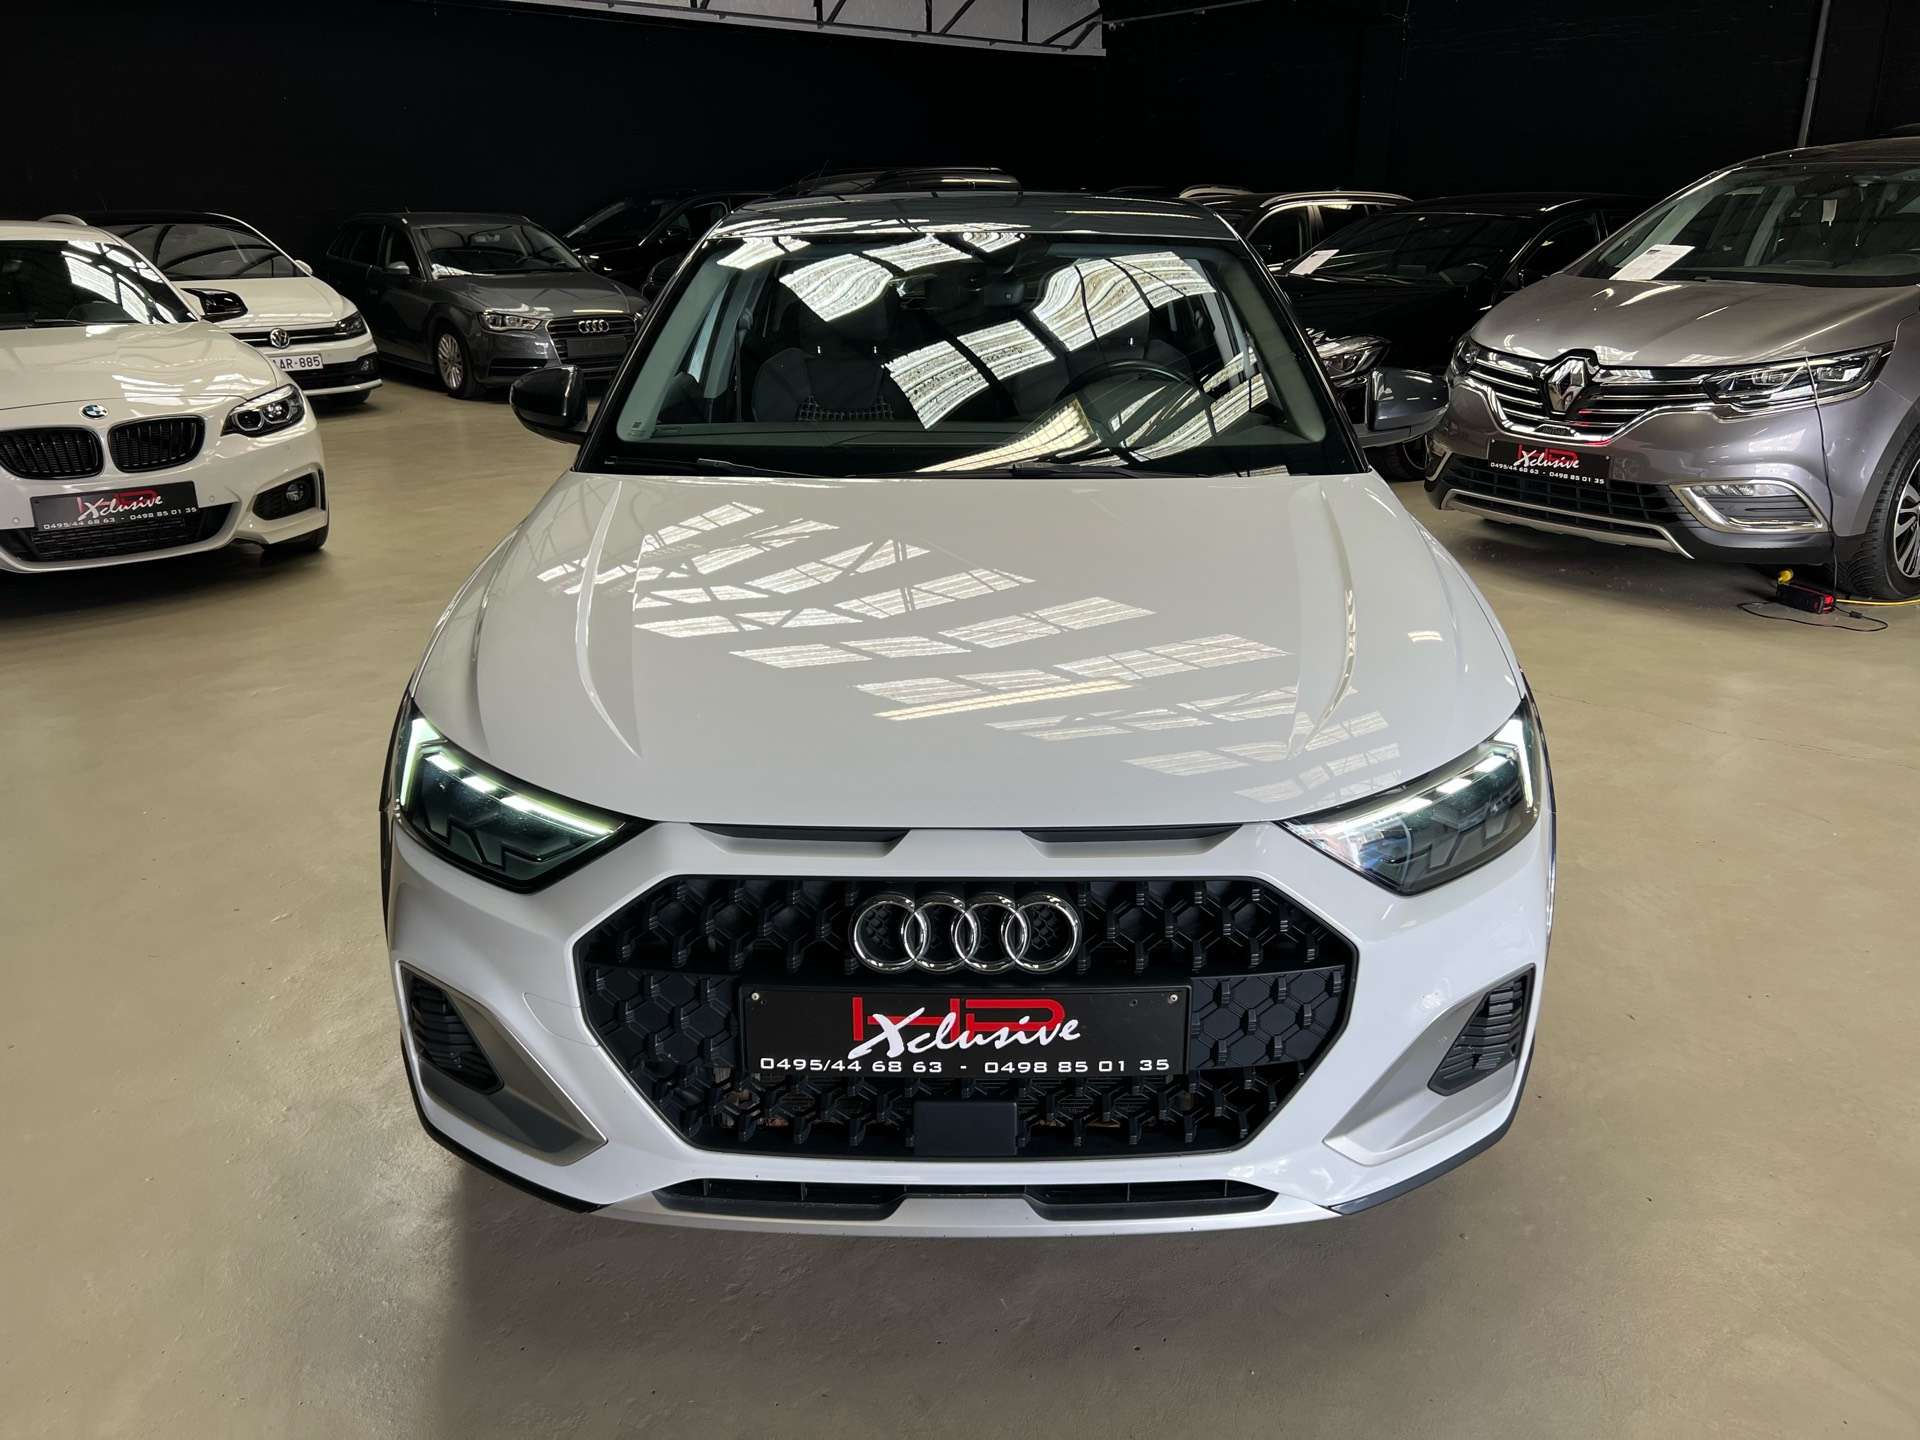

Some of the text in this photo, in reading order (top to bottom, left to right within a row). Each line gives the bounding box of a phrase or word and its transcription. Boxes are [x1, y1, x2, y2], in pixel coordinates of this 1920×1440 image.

[273, 356, 320, 368] AR-885
[1513, 449, 1580, 469] Xclusive
[77, 495, 164, 521] Xclusive
[848, 1007, 1081, 1060] Xclusive
[760, 1057, 862, 1073] 0495/44
[872, 1060, 902, 1074] 68
[912, 1060, 943, 1074] 63
[984, 1060, 1048, 1074] 0498
[1058, 1059, 1089, 1074] 85
[1098, 1059, 1126, 1073] 01
[1139, 1058, 1170, 1073] 35
